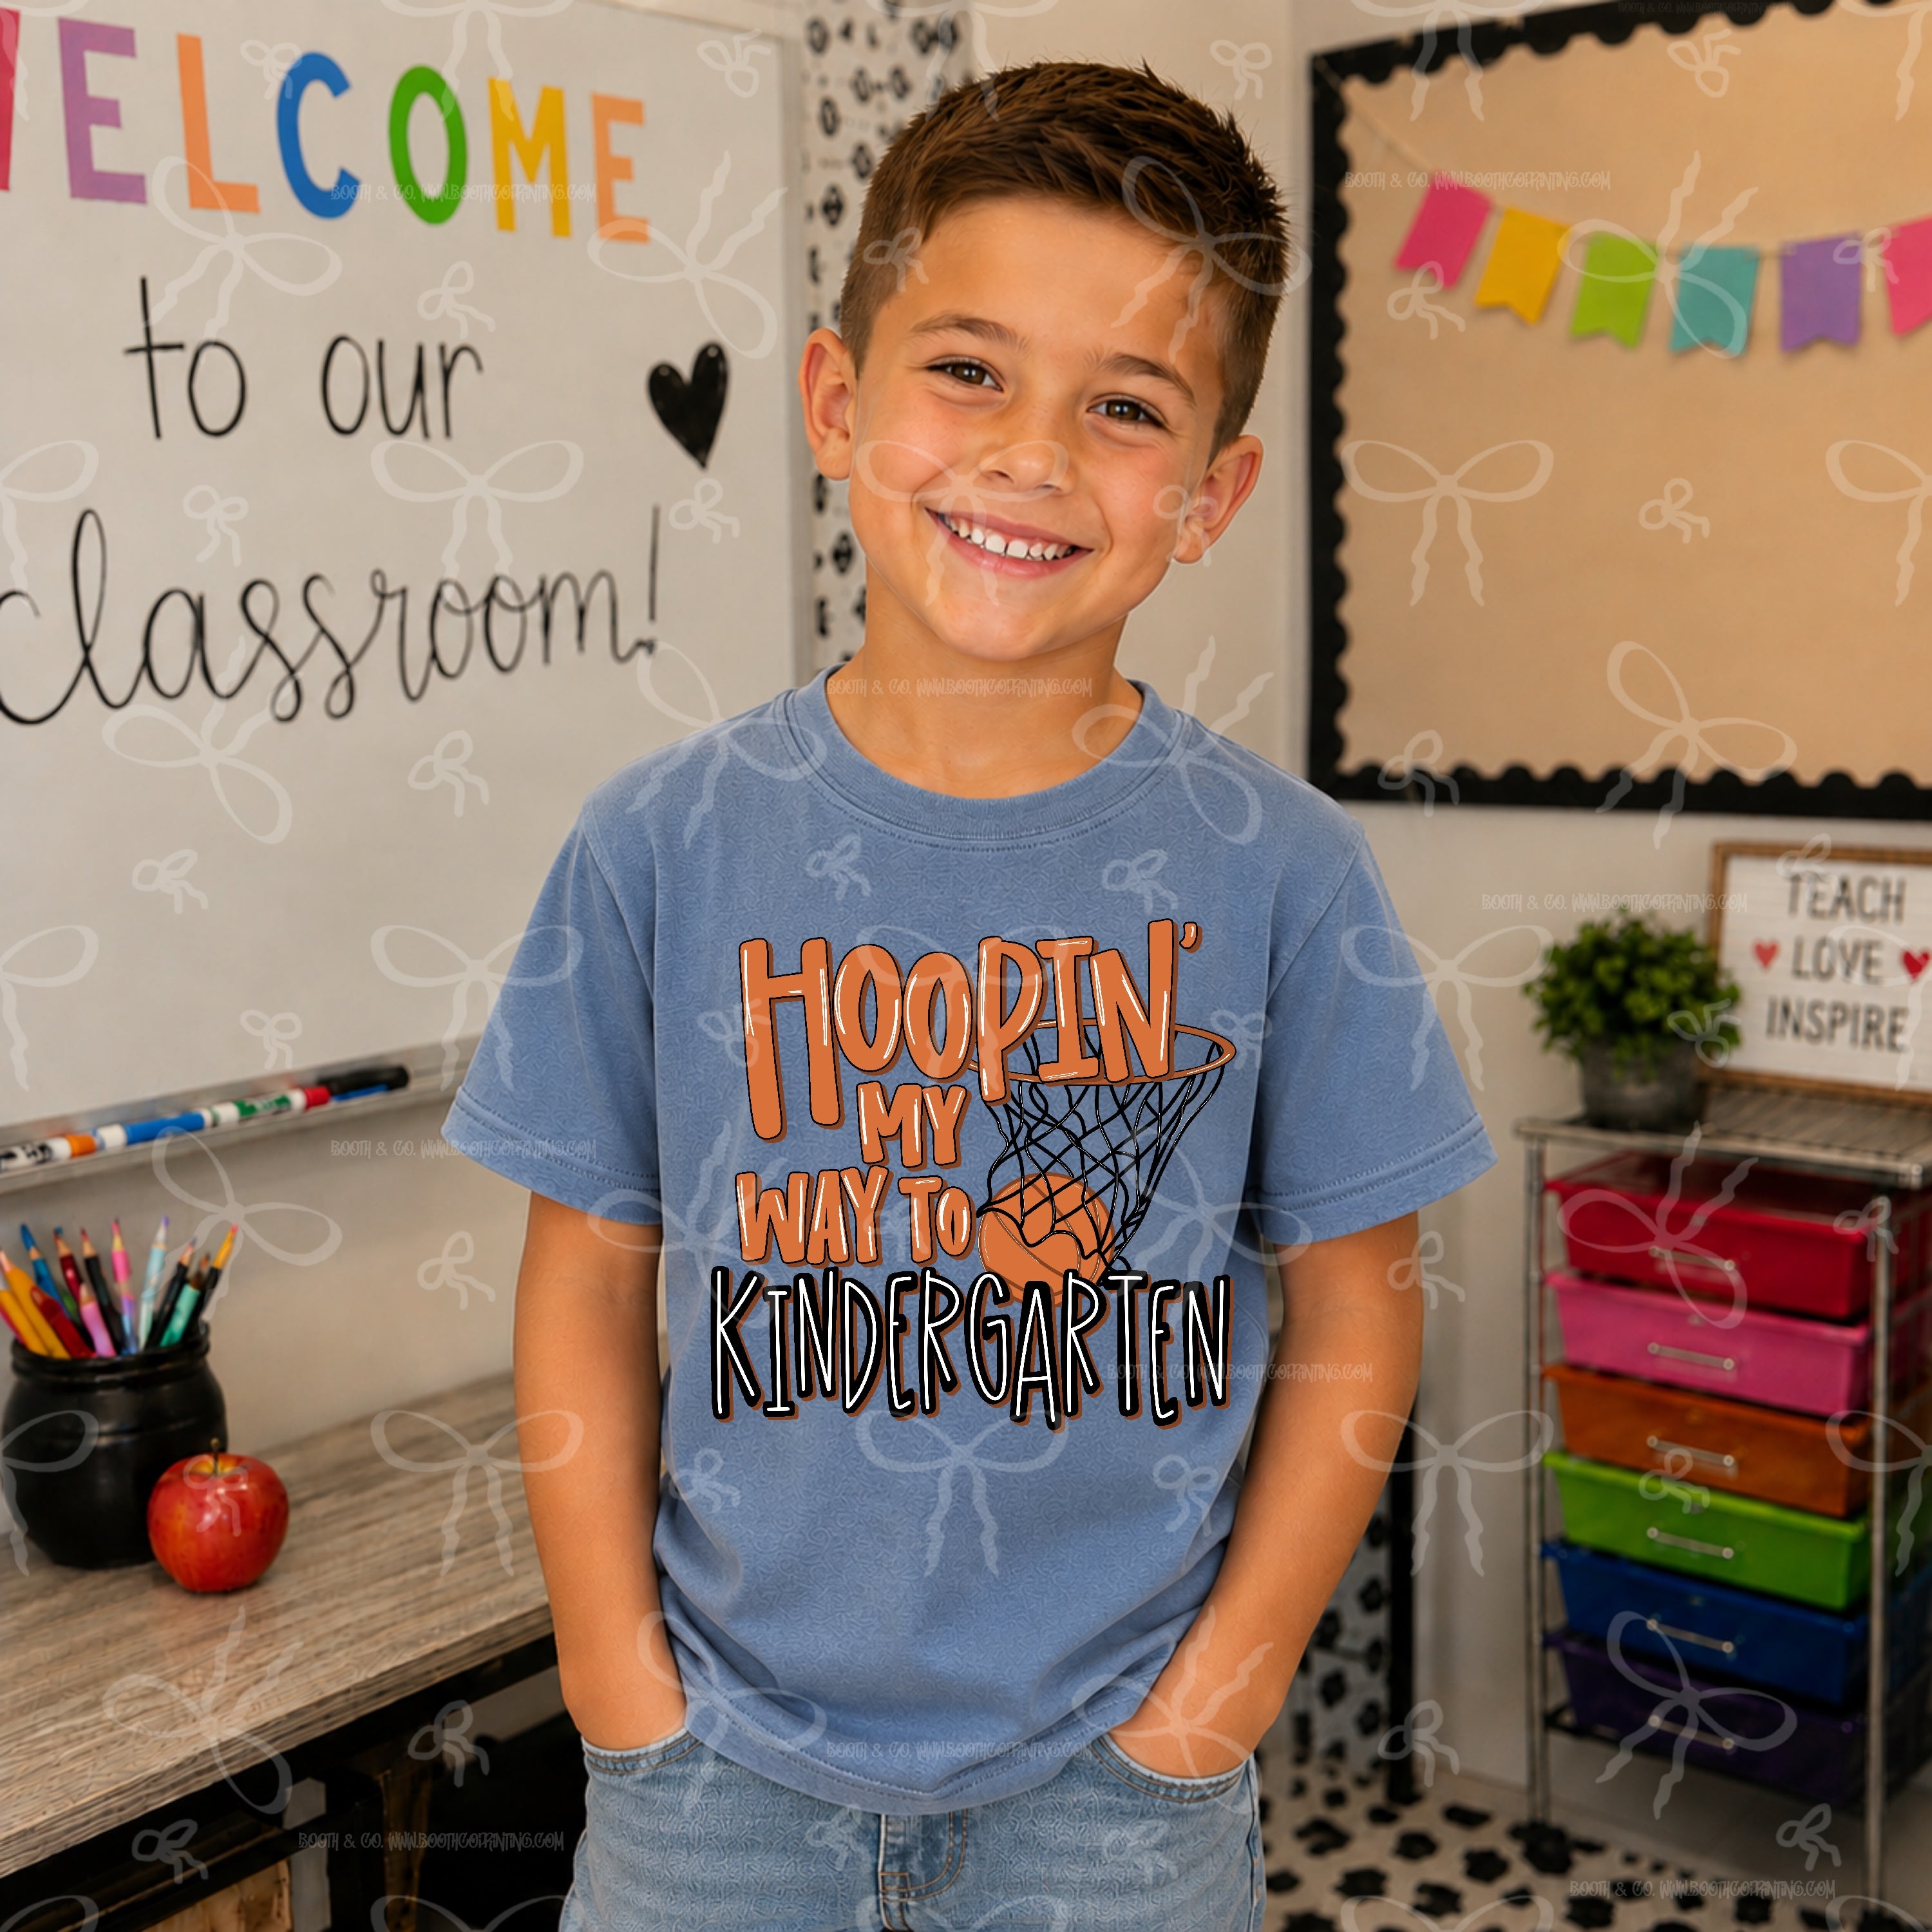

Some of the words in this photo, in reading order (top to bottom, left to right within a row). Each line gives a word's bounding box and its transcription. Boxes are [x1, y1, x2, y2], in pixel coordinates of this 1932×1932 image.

[0, 7, 650, 244] ELCOME
[123, 276, 247, 439] to
[321, 335, 483, 439] our
[1785, 872, 1908, 924] TEACH
[1790, 935, 1884, 985] LOVE
[739, 918, 1202, 1143] HOOPIN'
[1765, 994, 1910, 1054] INSPIRE
[857, 1081, 971, 1169] MY
[735, 1164, 893, 1269] WAY
[898, 1175, 977, 1266] TO
[710, 1266, 1235, 1434] KINDERGARTEN
